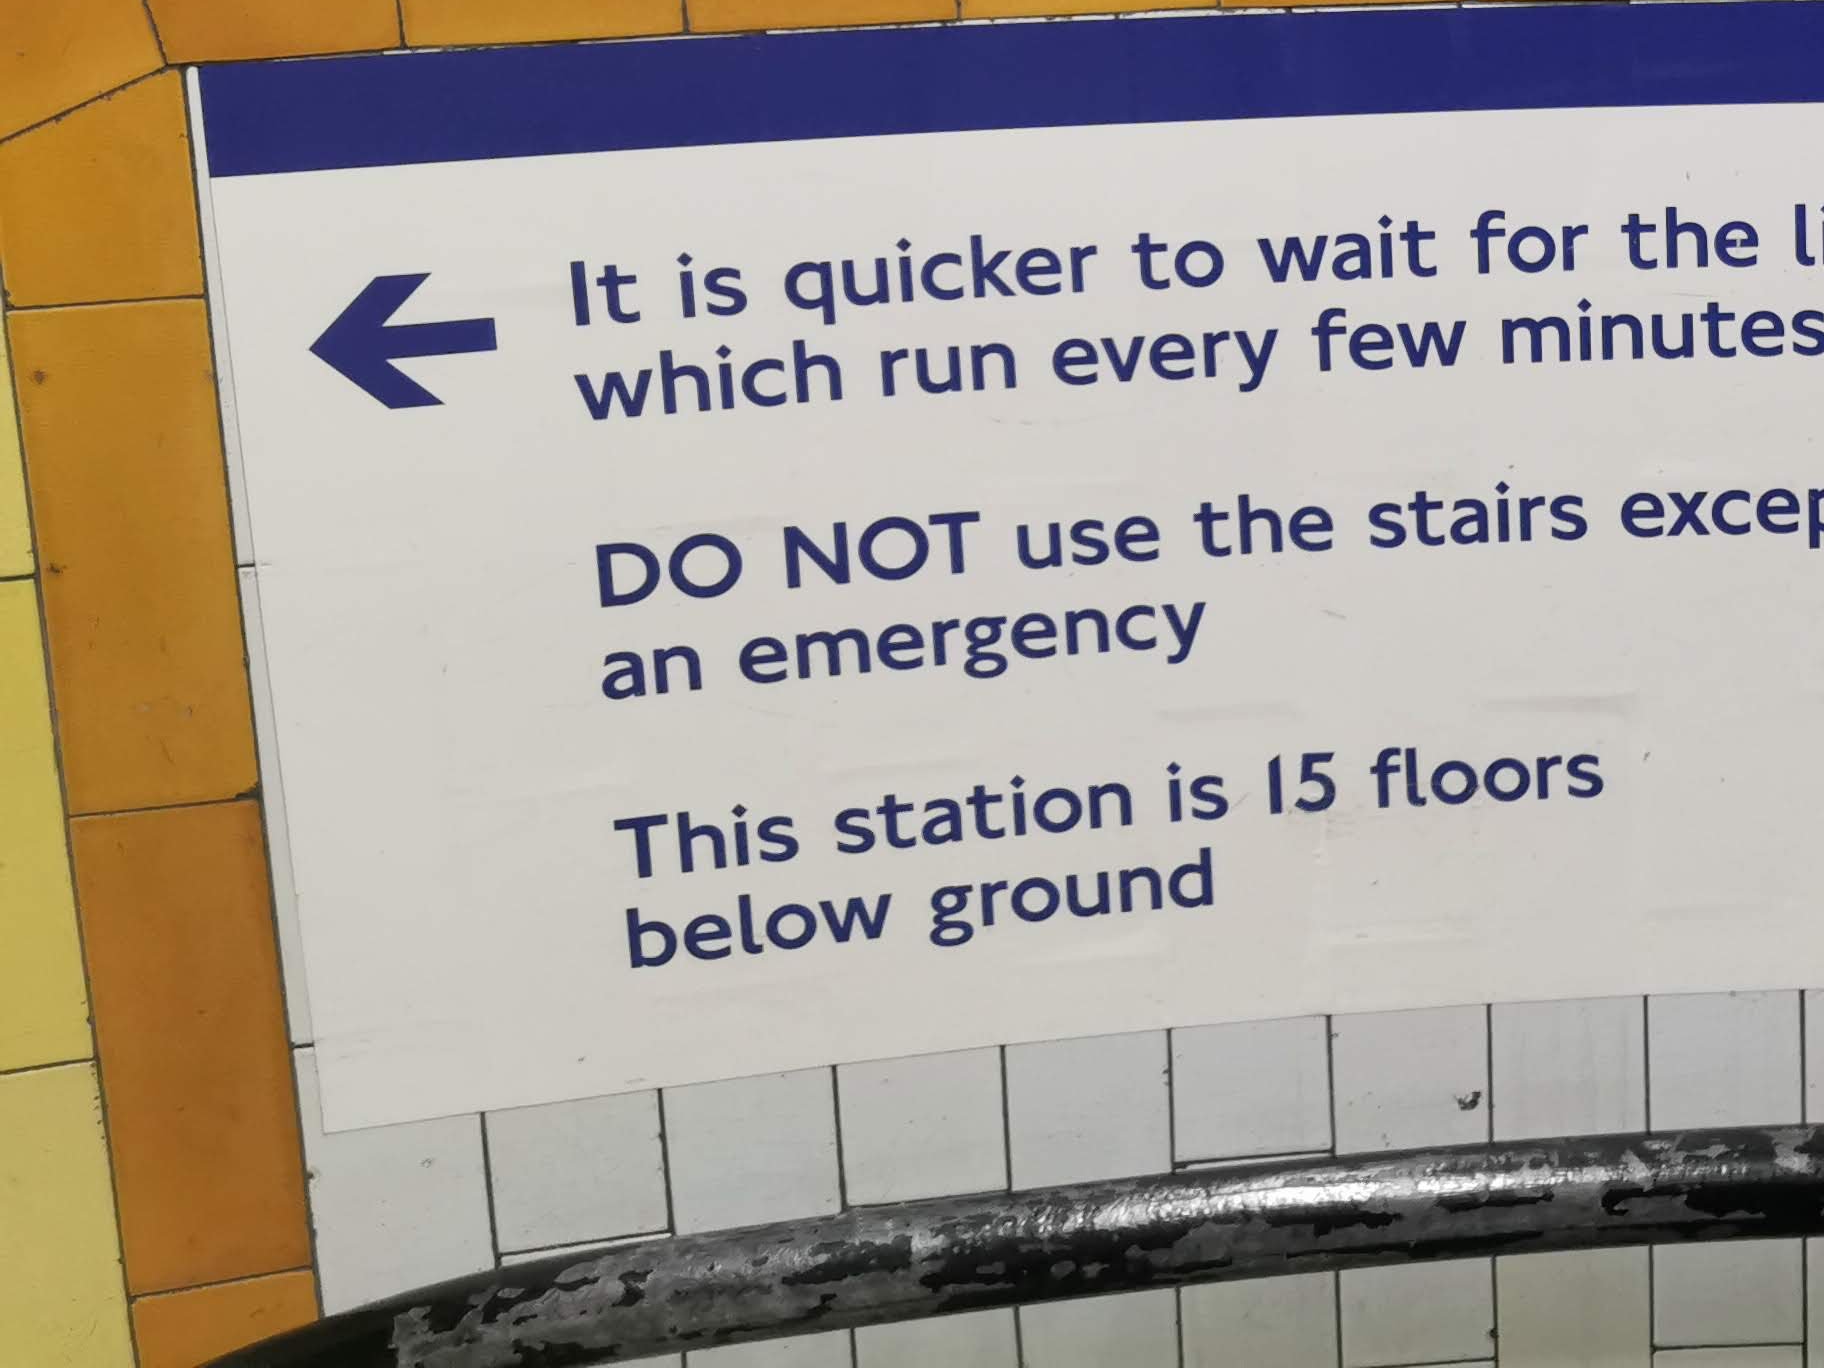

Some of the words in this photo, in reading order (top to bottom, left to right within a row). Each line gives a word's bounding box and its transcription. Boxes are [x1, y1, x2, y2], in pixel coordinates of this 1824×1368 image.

[570, 261, 642, 328] It
[678, 251, 748, 320] is
[785, 231, 1098, 326] quicker
[1130, 232, 1227, 293] to
[1258, 212, 1439, 284] wait
[1469, 209, 1591, 276] for
[1621, 205, 1761, 272] the
[574, 340, 844, 421] which
[880, 341, 1018, 398] run
[1053, 328, 1280, 395] every
[1310, 307, 1467, 372] few
[595, 533, 744, 606] DO
[783, 512, 980, 588] NOT
[1016, 516, 1162, 571] use
[1193, 495, 1334, 559] the
[1368, 480, 1589, 551] stairs
[602, 646, 703, 700] an
[739, 602, 1208, 685] emergency
[614, 800, 799, 876] This
[835, 773, 1133, 854] station
[1168, 760, 1229, 825] is
[1268, 751, 1334, 816] 15
[1368, 747, 1604, 812] floors
[627, 894, 891, 967] below
[930, 847, 1215, 949] ground
